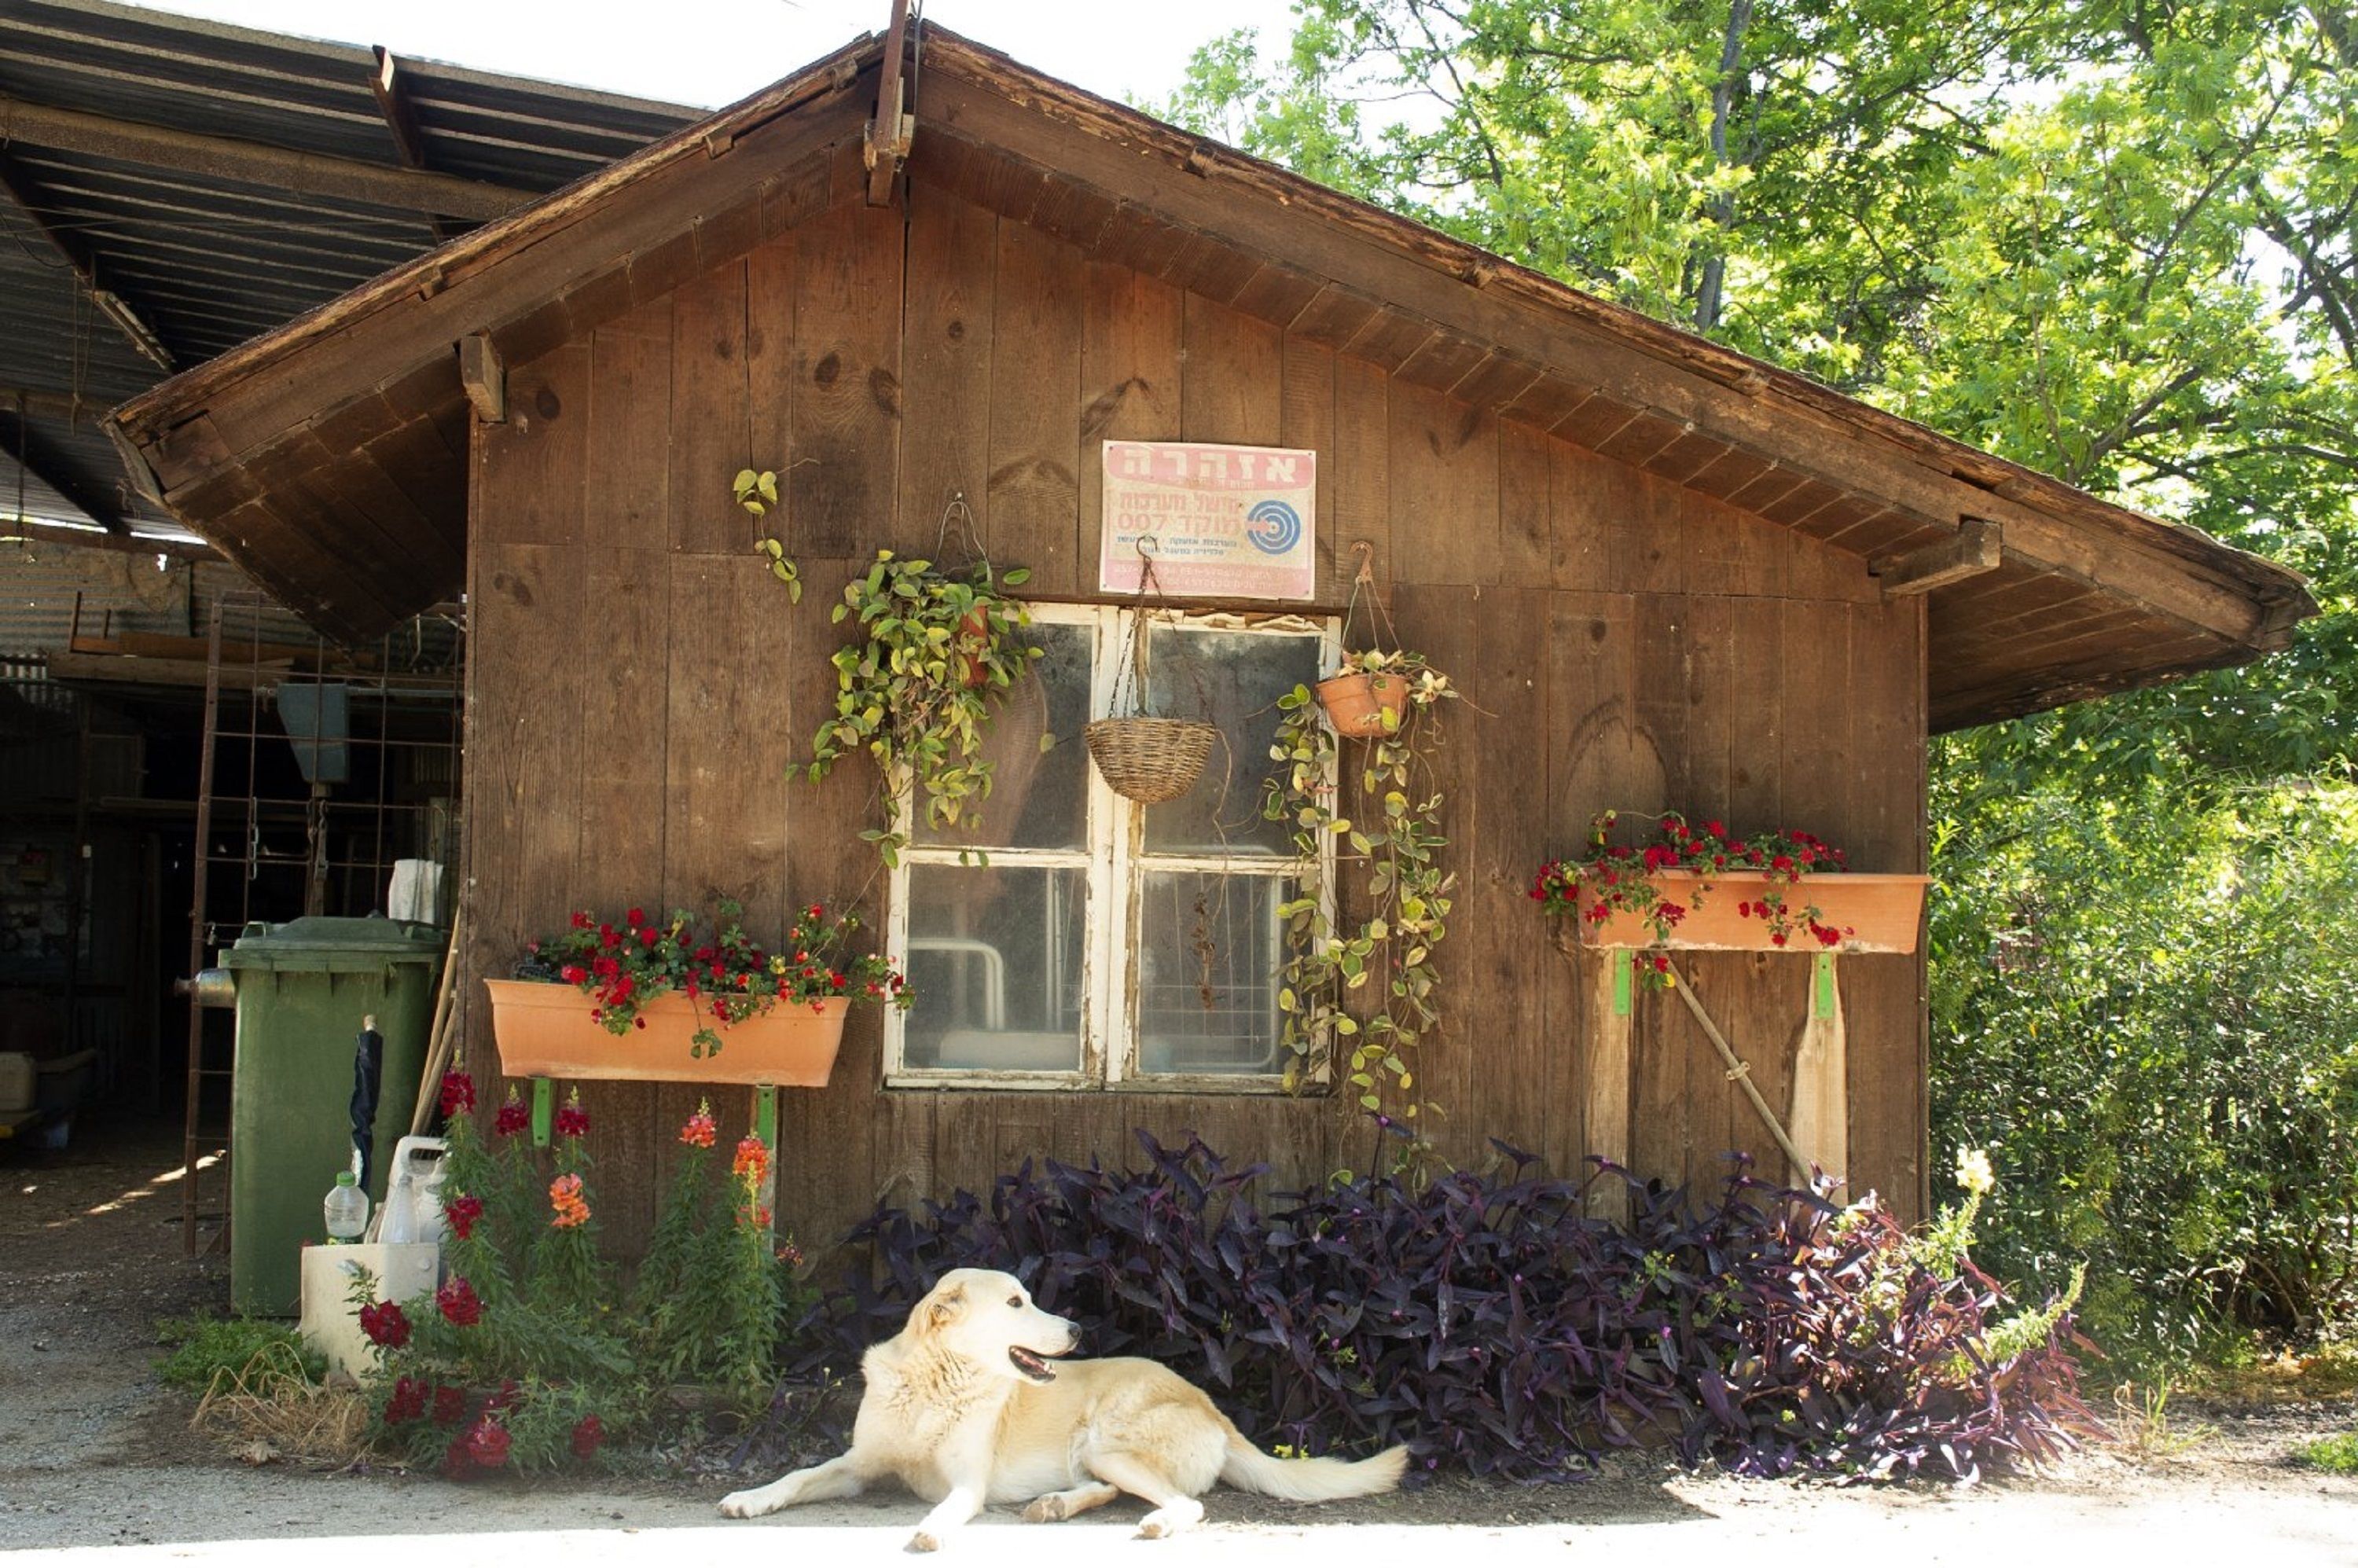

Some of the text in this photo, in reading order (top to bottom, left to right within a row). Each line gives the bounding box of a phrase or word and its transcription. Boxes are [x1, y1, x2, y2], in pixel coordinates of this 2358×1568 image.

[1123, 449, 1296, 483] אזהרה
[1120, 492, 1187, 511] מערכות
[1118, 512, 1241, 537] מוקד 007
